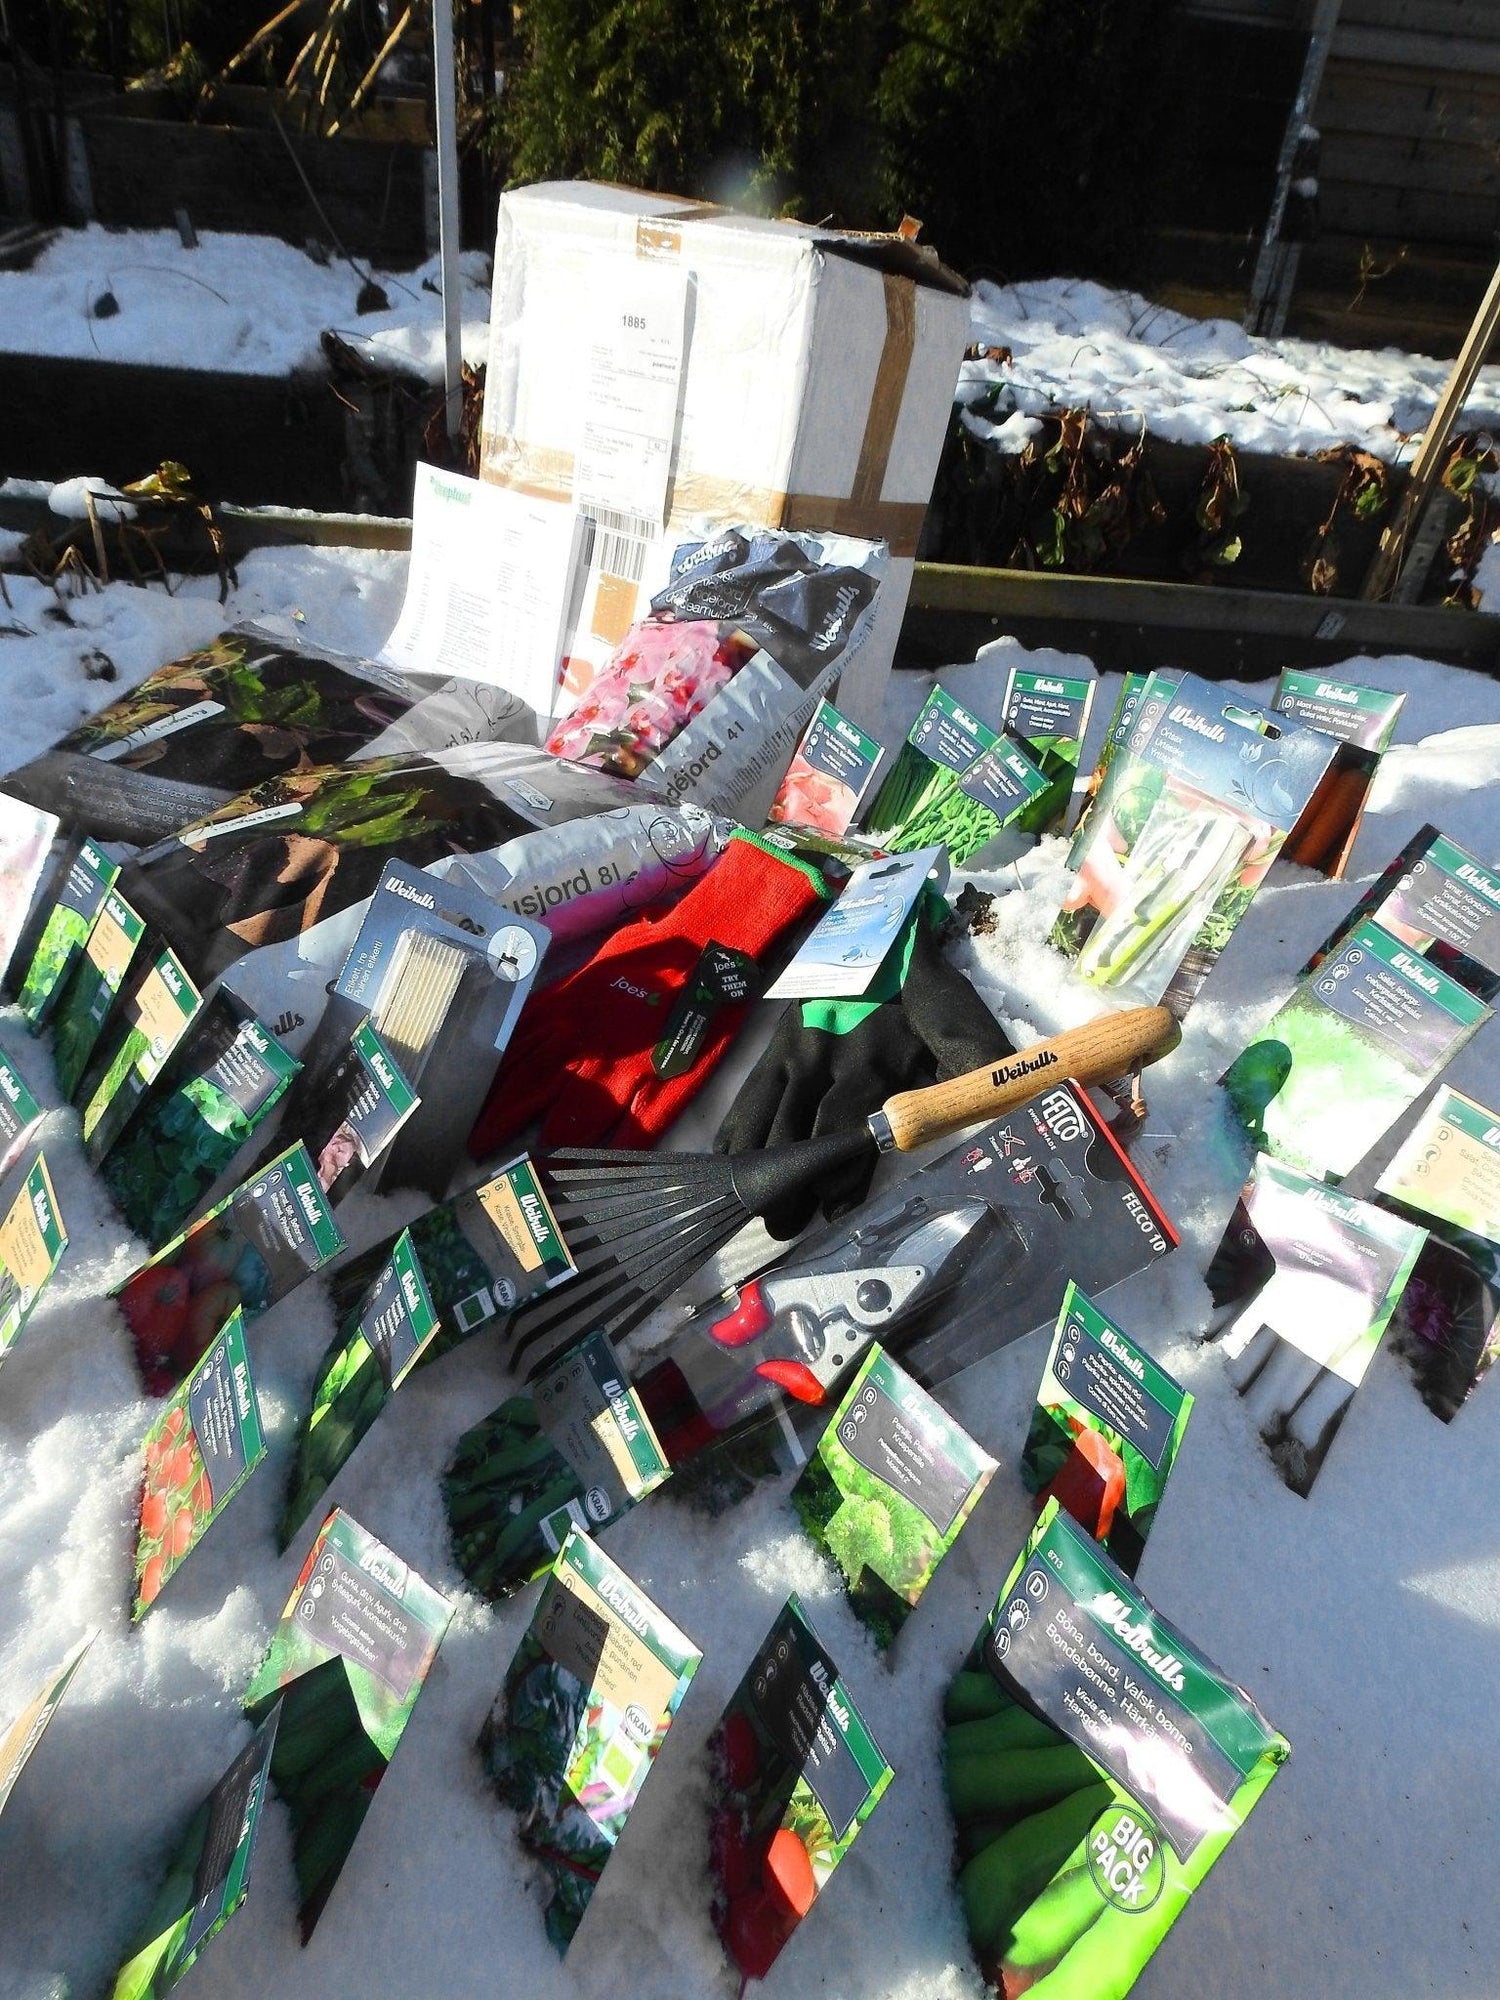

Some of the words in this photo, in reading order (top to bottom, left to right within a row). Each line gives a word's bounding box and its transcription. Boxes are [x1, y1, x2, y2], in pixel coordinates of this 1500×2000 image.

[623, 314, 646, 330] 1885
[1169, 705, 1226, 743] Weibulls
[385, 877, 436, 910] Weibulls
[610, 976, 649, 999] Joe's
[714, 959, 736, 973] Joe's
[721, 980, 747, 992] THEM
[722, 974, 739, 983] TRY
[1389, 952, 1440, 995] Weibulls
[731, 989, 744, 998] ON
[991, 1050, 1058, 1087] Weibulls
[1027, 1107, 1041, 1127] SWISS
[1042, 1133, 1057, 1151] MADE
[1041, 1090, 1083, 1142] FELCO
[296, 1182, 322, 1226] Weibulls
[520, 1193, 550, 1243] Weibulls
[1122, 1192, 1154, 1233] FELCO
[1149, 1234, 1168, 1251] 10
[1303, 1188, 1365, 1227] Weibulls
[498, 1280, 511, 1303] KRAV
[1100, 1328, 1145, 1380] Weibulls
[602, 1379, 640, 1442] Weibulls
[589, 1488, 606, 1517] KRAV
[359, 1549, 405, 1600] Weibulls
[1046, 1550, 1064, 1569] 8713
[597, 1573, 651, 1638] Weibulls
[1092, 1591, 1186, 1692] Weibulls
[1045, 1623, 1117, 1704] Bondebønne,
[1055, 1609, 1085, 1648] Böna,
[1088, 1642, 1120, 1683] bond,
[1122, 1675, 1155, 1715] Valsk
[1155, 1708, 1194, 1754] bønne
[809, 1660, 850, 1732] Weibulls
[1075, 1687, 1098, 1712] Vicia
[627, 1708, 652, 1737] KRAV
[1110, 1813, 1156, 1873] BIG
[1091, 1832, 1149, 1905] PACK
